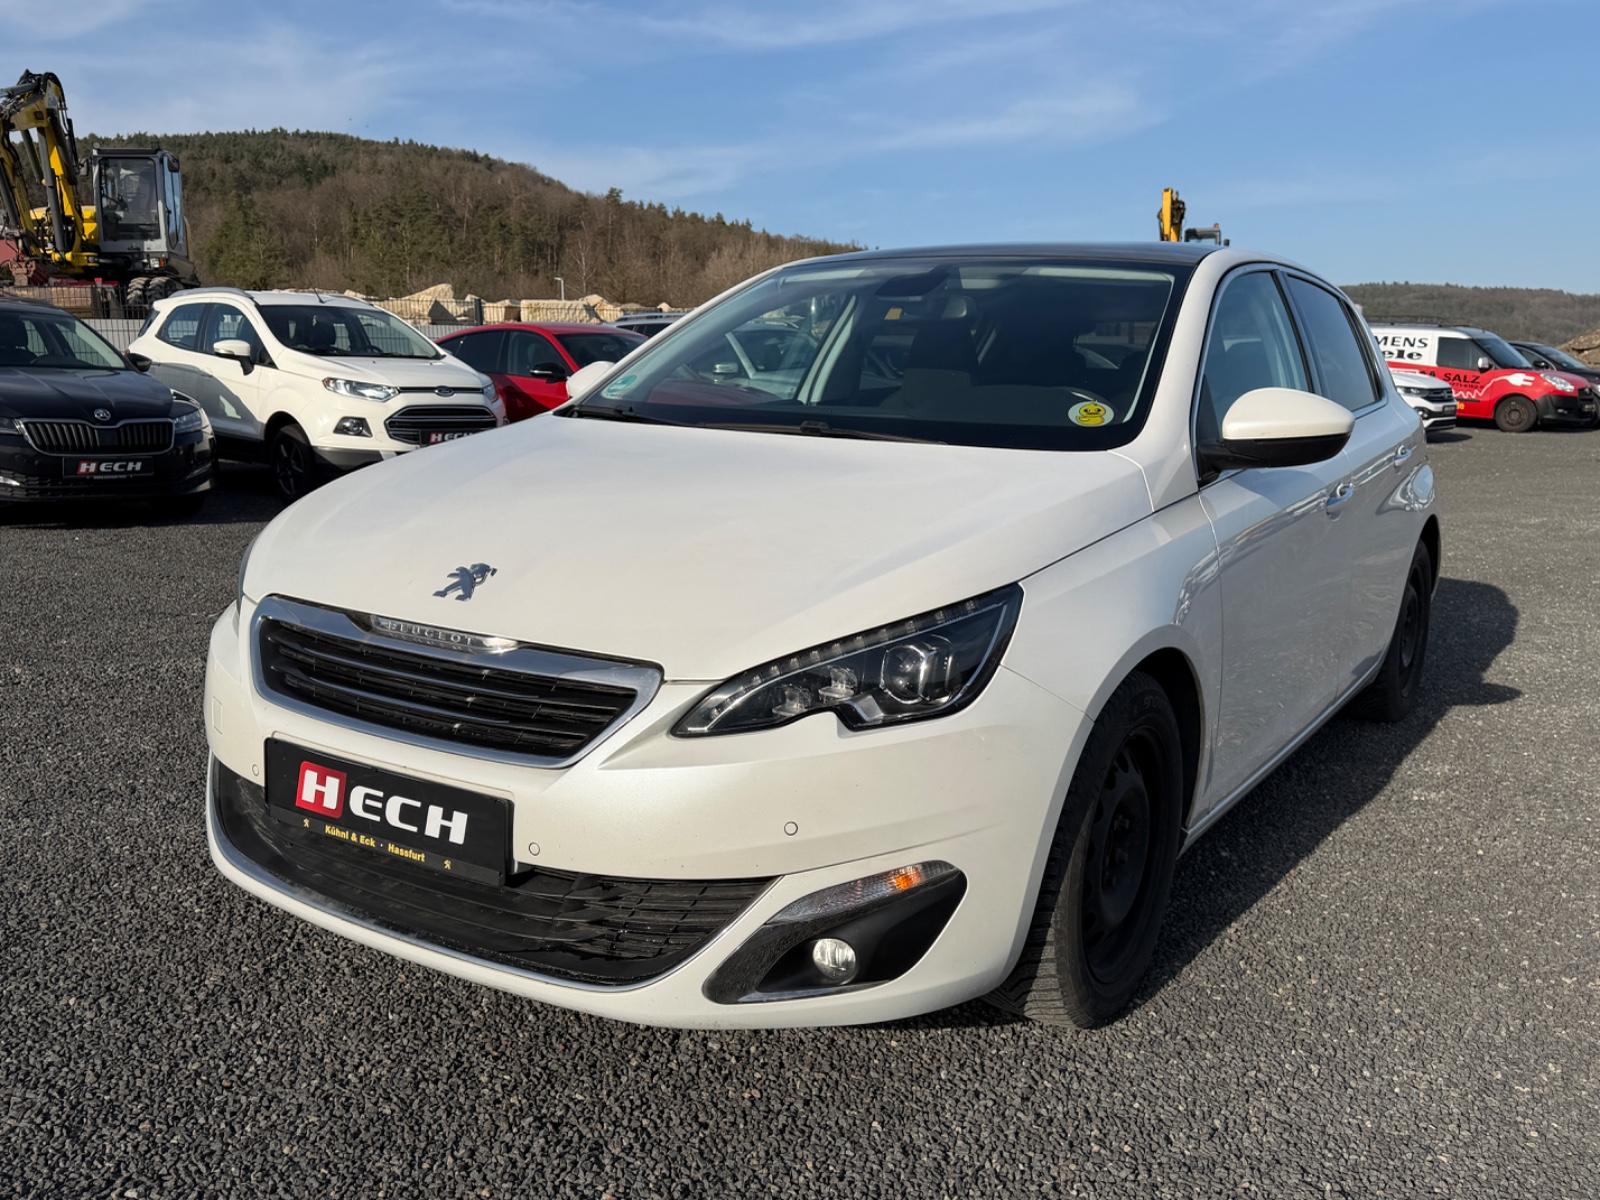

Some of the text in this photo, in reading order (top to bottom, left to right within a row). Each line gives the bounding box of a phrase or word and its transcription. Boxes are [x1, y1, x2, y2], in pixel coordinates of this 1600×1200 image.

[79, 462, 142, 473] HECH
[301, 769, 468, 845] HECH
[351, 832, 358, 842] &
[359, 835, 376, 848] Eck
[388, 843, 425, 862] Hassfurt
